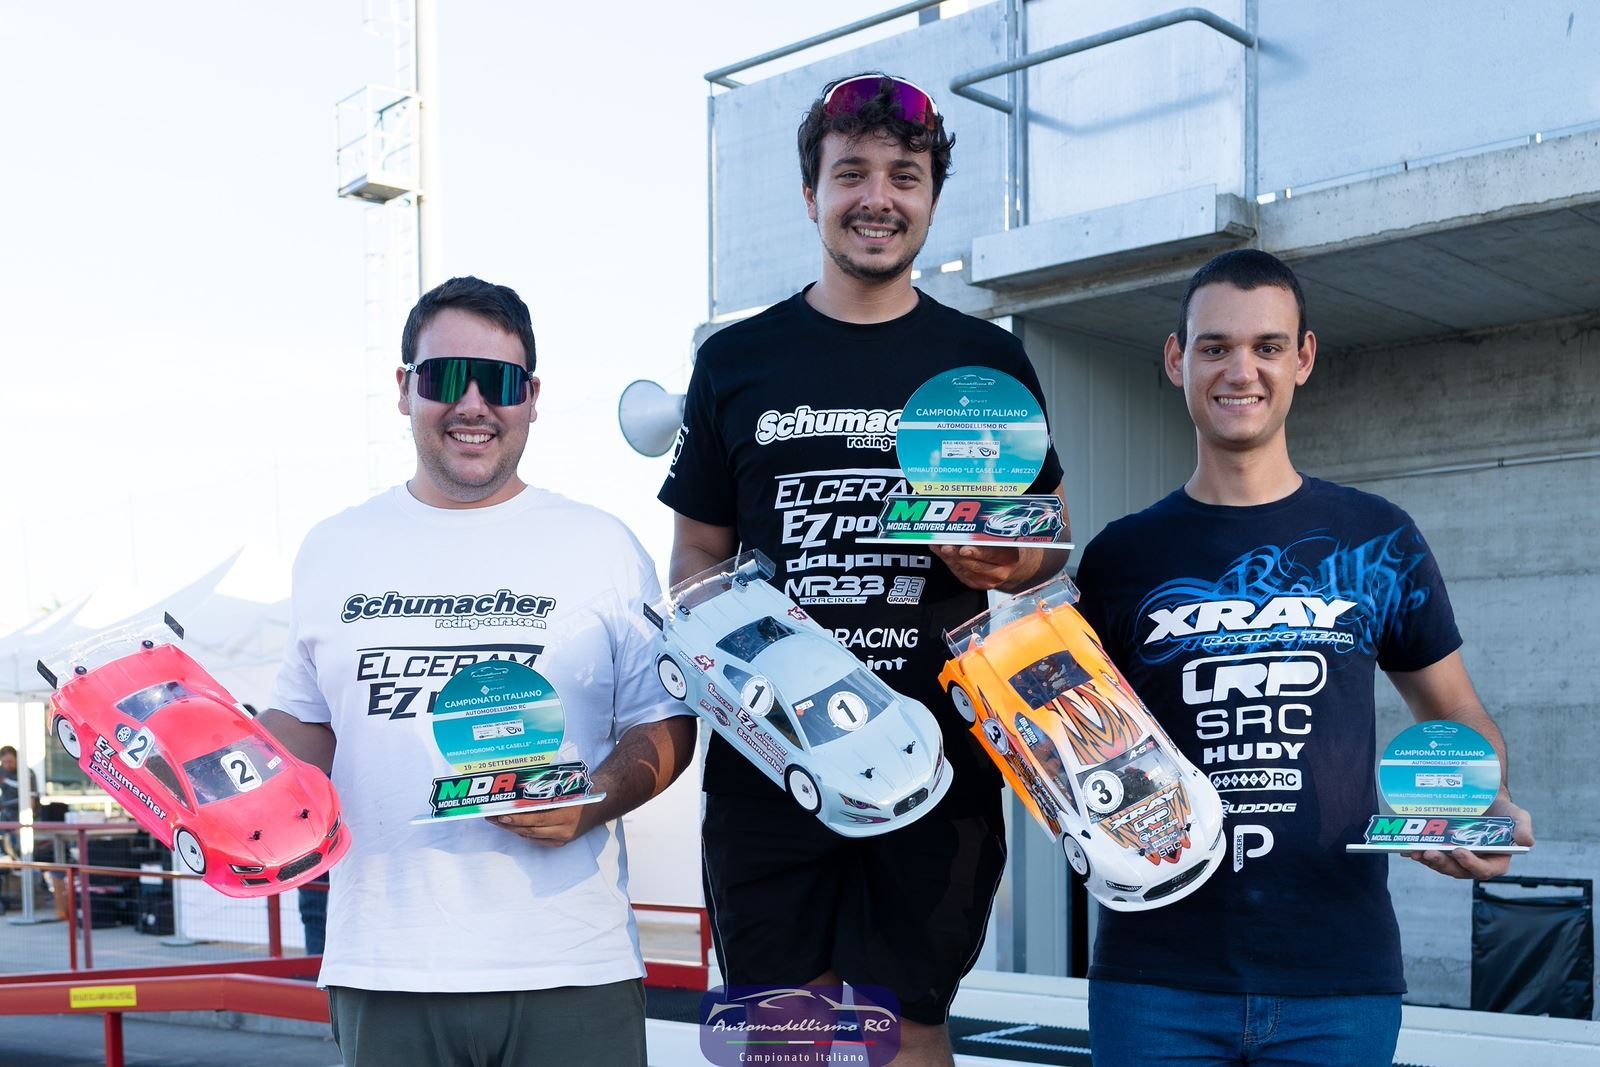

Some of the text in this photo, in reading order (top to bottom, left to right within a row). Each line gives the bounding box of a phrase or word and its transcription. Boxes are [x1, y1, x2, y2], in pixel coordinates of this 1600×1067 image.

[916, 408, 1028, 417] CAMPIONATO ITALIANO
[755, 405, 903, 445] Schumac
[774, 478, 917, 509] ELCERA
[887, 500, 982, 523] MDA
[886, 522, 976, 531] MODEL DRIVERS AREZZO
[784, 575, 885, 598] MR33
[341, 589, 556, 623] Schumacher
[435, 616, 547, 630] racing-cars.com
[1143, 596, 1358, 645] XRAY
[1203, 632, 1354, 646] RACING TEAM
[1182, 651, 1327, 705] LRP
[367, 682, 423, 720] EZ
[444, 695, 500, 709] CAMPIONATO
[503, 689, 542, 700] ITALIANO
[749, 684, 766, 709] 1
[465, 705, 518, 716] AUTOMODELLISMO
[837, 699, 857, 723] 1
[1196, 704, 1312, 740] SRC
[537, 738, 559, 746] AREZZO
[988, 725, 1001, 744] 3
[1019, 717, 1040, 745] ORLANDO
[128, 735, 148, 762] 2
[737, 727, 784, 775] Schumacher
[1203, 742, 1305, 765] HUDY
[230, 759, 255, 784] 2
[488, 757, 528, 768] SETTEMBRE
[530, 754, 546, 762] 2026
[92, 750, 167, 819] Schumacher
[437, 773, 518, 800] MDA
[1091, 779, 1112, 804] 3
[1213, 773, 1297, 787] MONACO RC
[438, 792, 516, 809] MODEL DRIVERS AREZZO
[1110, 787, 1179, 831] XRAY
[1133, 806, 1171, 832] LRP
[1372, 818, 1448, 835] MDA
[1159, 840, 1182, 857] SRC
